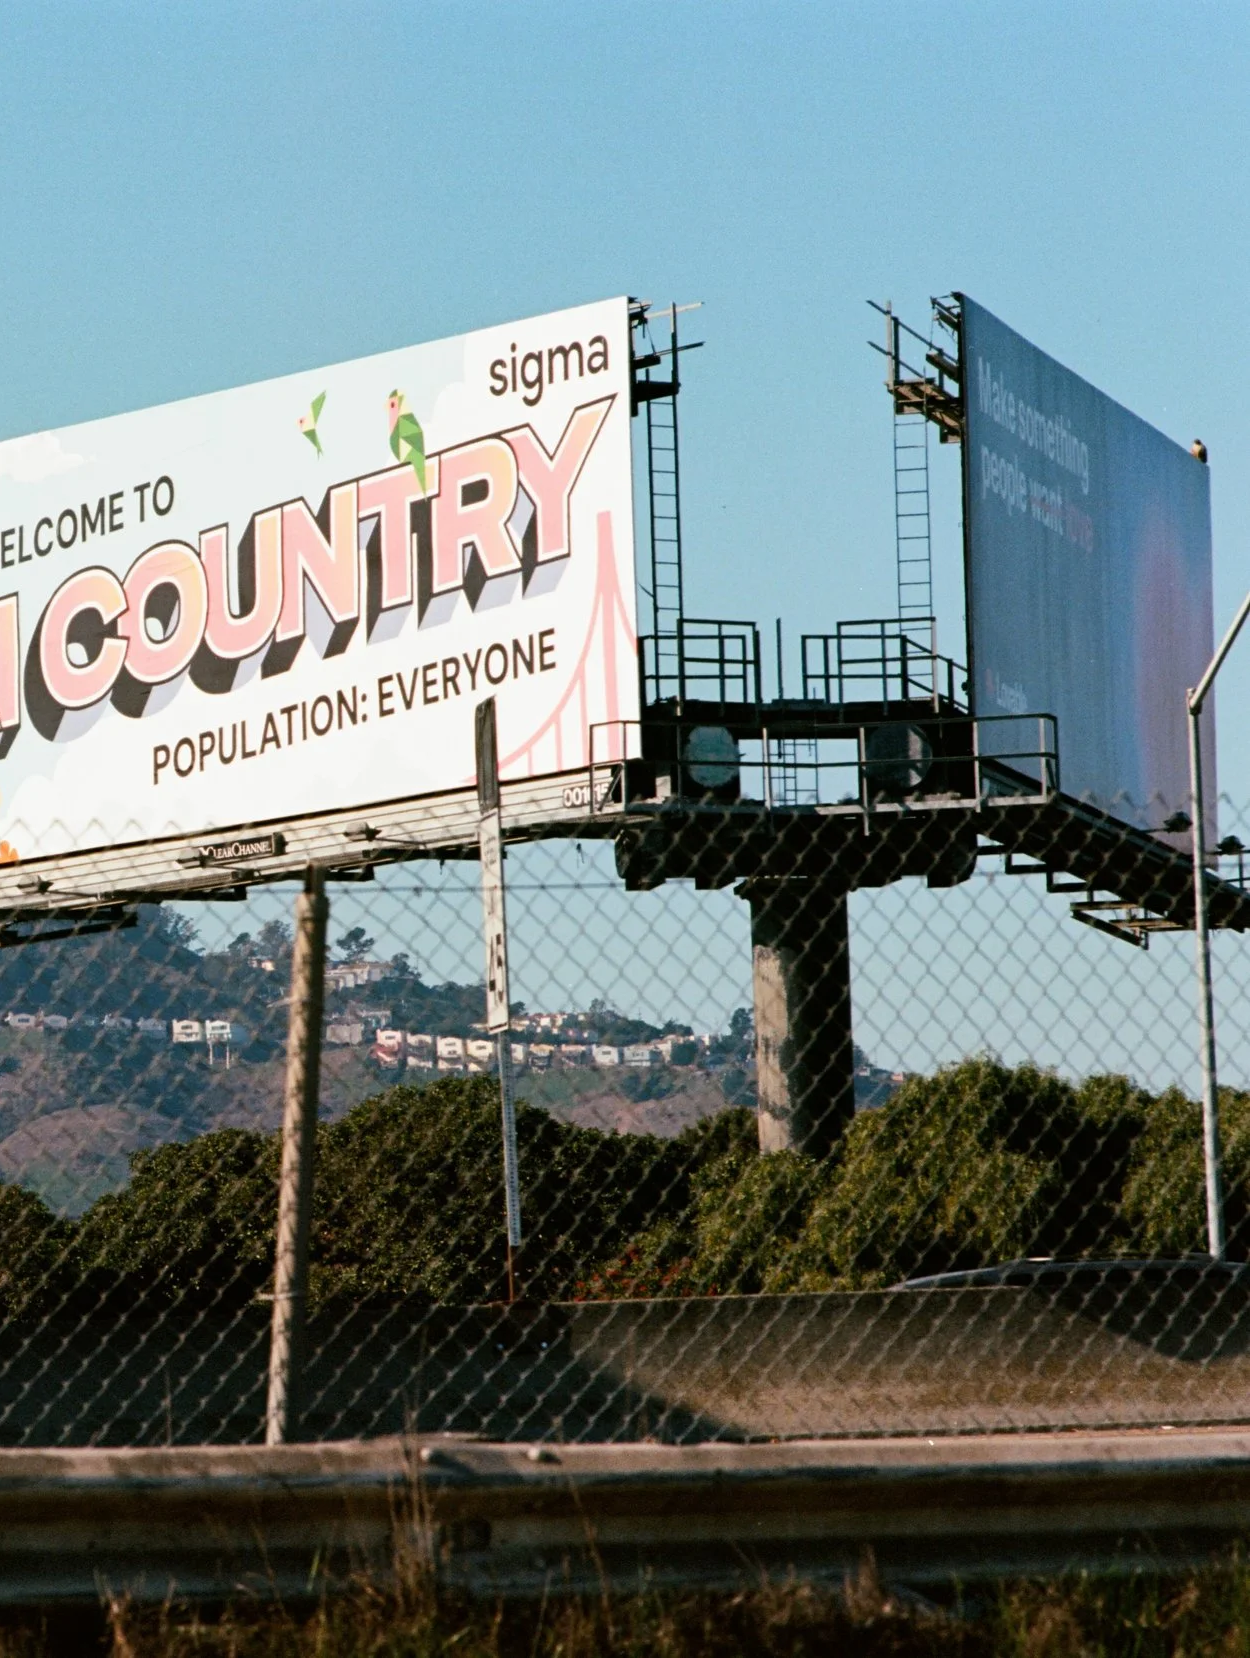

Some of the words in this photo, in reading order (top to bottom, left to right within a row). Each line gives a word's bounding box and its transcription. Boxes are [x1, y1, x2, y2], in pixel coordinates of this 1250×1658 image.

[488, 334, 610, 406] sigma
[978, 356, 1016, 434] Make
[1018, 399, 1090, 496] something
[132, 475, 176, 522] TO
[981, 444, 1028, 517] people
[24, 392, 618, 744] COUNTRY
[152, 685, 369, 786] POPULATION:
[377, 627, 557, 718] EVERYONE
